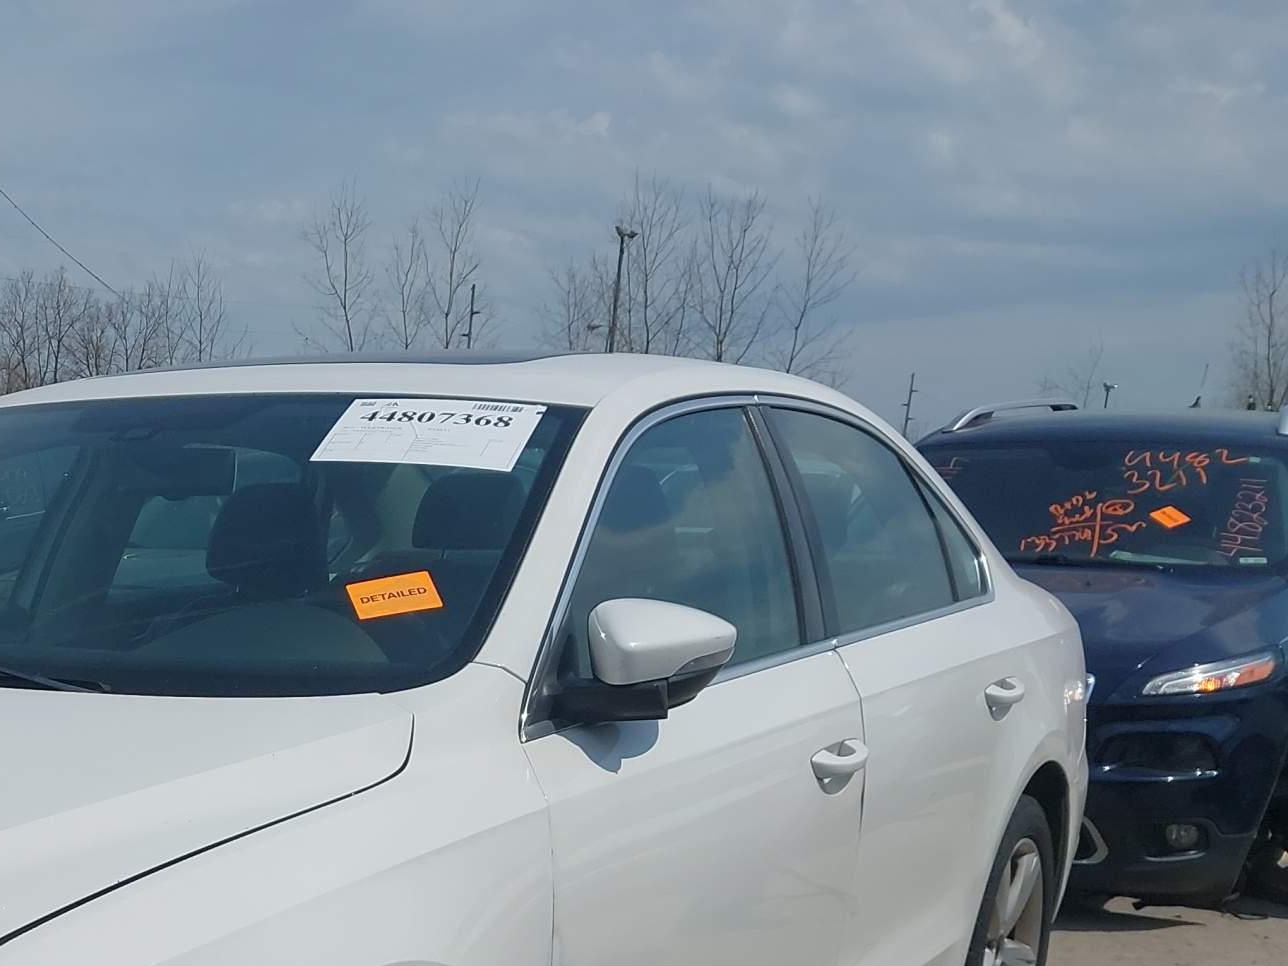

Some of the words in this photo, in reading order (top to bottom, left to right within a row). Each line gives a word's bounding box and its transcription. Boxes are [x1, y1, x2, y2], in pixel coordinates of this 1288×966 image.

[360, 409, 514, 429] 44807368
[1124, 448, 1250, 471] 4482
[1123, 467, 1208, 494] 3211
[358, 585, 428, 605] DETAILED
